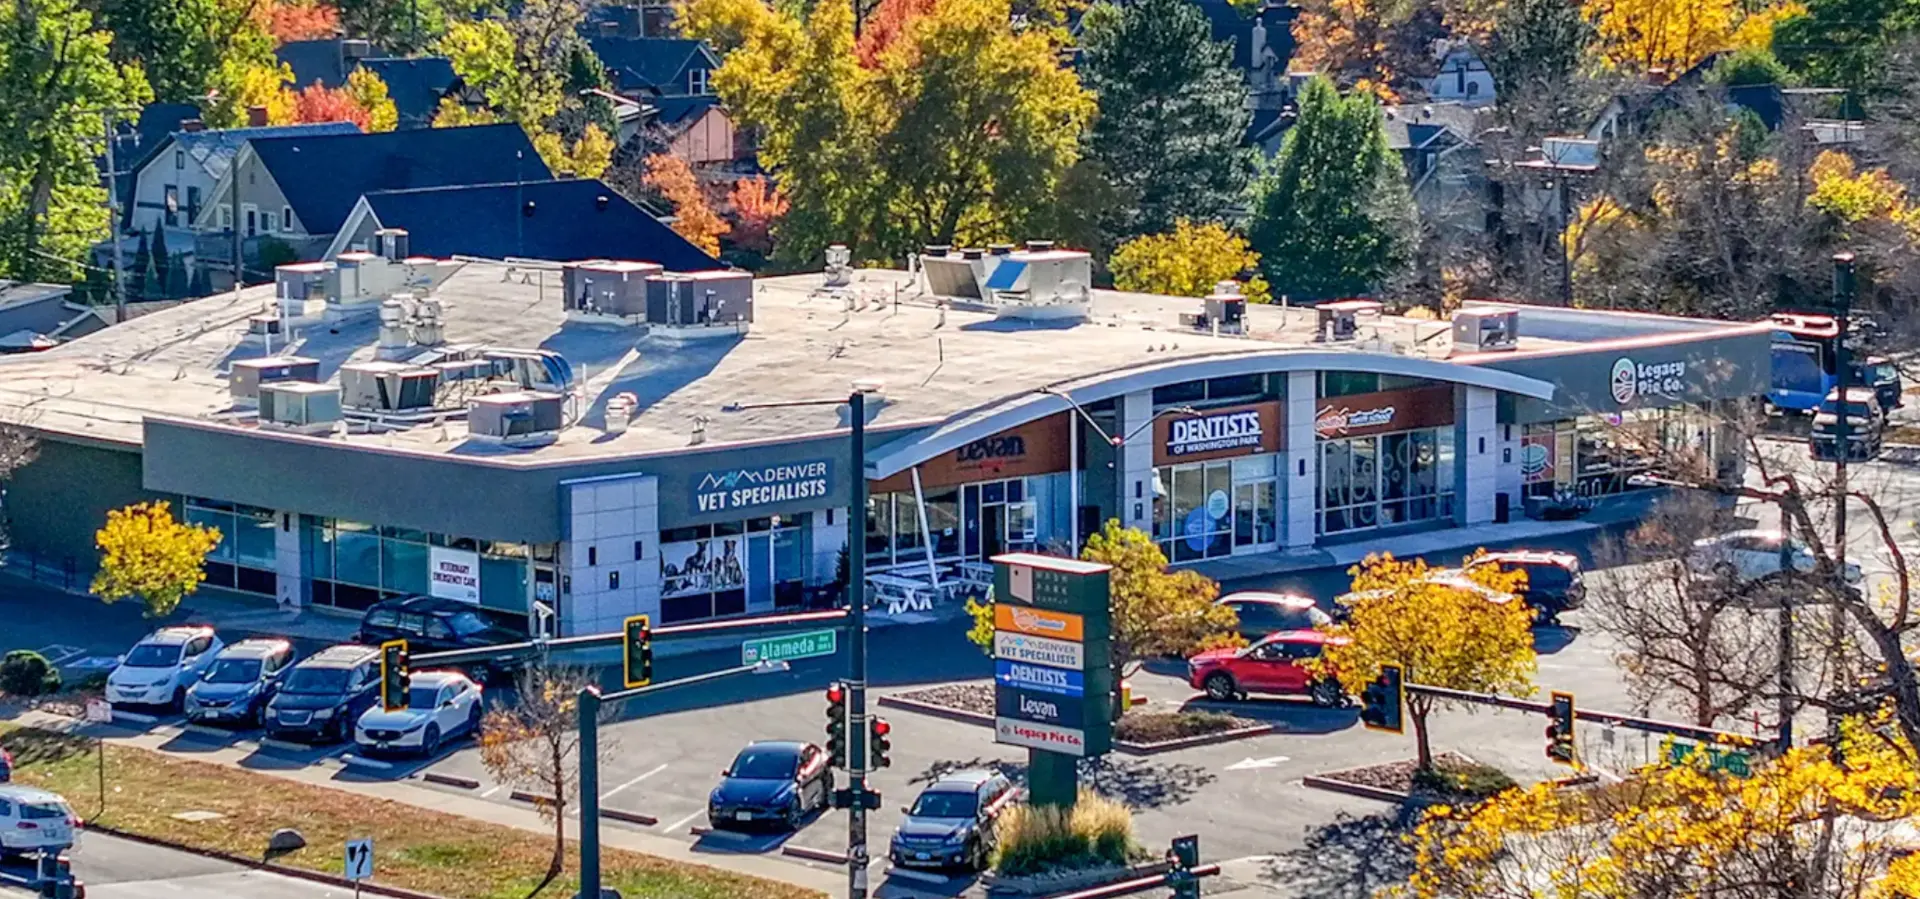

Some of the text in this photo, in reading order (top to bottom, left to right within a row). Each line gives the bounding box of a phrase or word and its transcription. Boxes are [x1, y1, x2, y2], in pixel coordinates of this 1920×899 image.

[1637, 361, 1685, 379] Legacy
[1638, 377, 1684, 395] Pie Co.
[1173, 412, 1259, 442] DENTISTS
[1174, 436, 1259, 454] OF WASHINGTON PARK
[764, 462, 827, 483] DENVER
[698, 479, 827, 511] VET SPECIALISTS
[760, 638, 815, 658] Alameda
[1000, 645, 1076, 665] VET SPECIALISTS
[1036, 642, 1076, 653] DENVER
[1010, 664, 1067, 687] DENTISTS
[1020, 694, 1058, 717] Levan
[1014, 725, 1082, 746] Legacy Pie Co.
